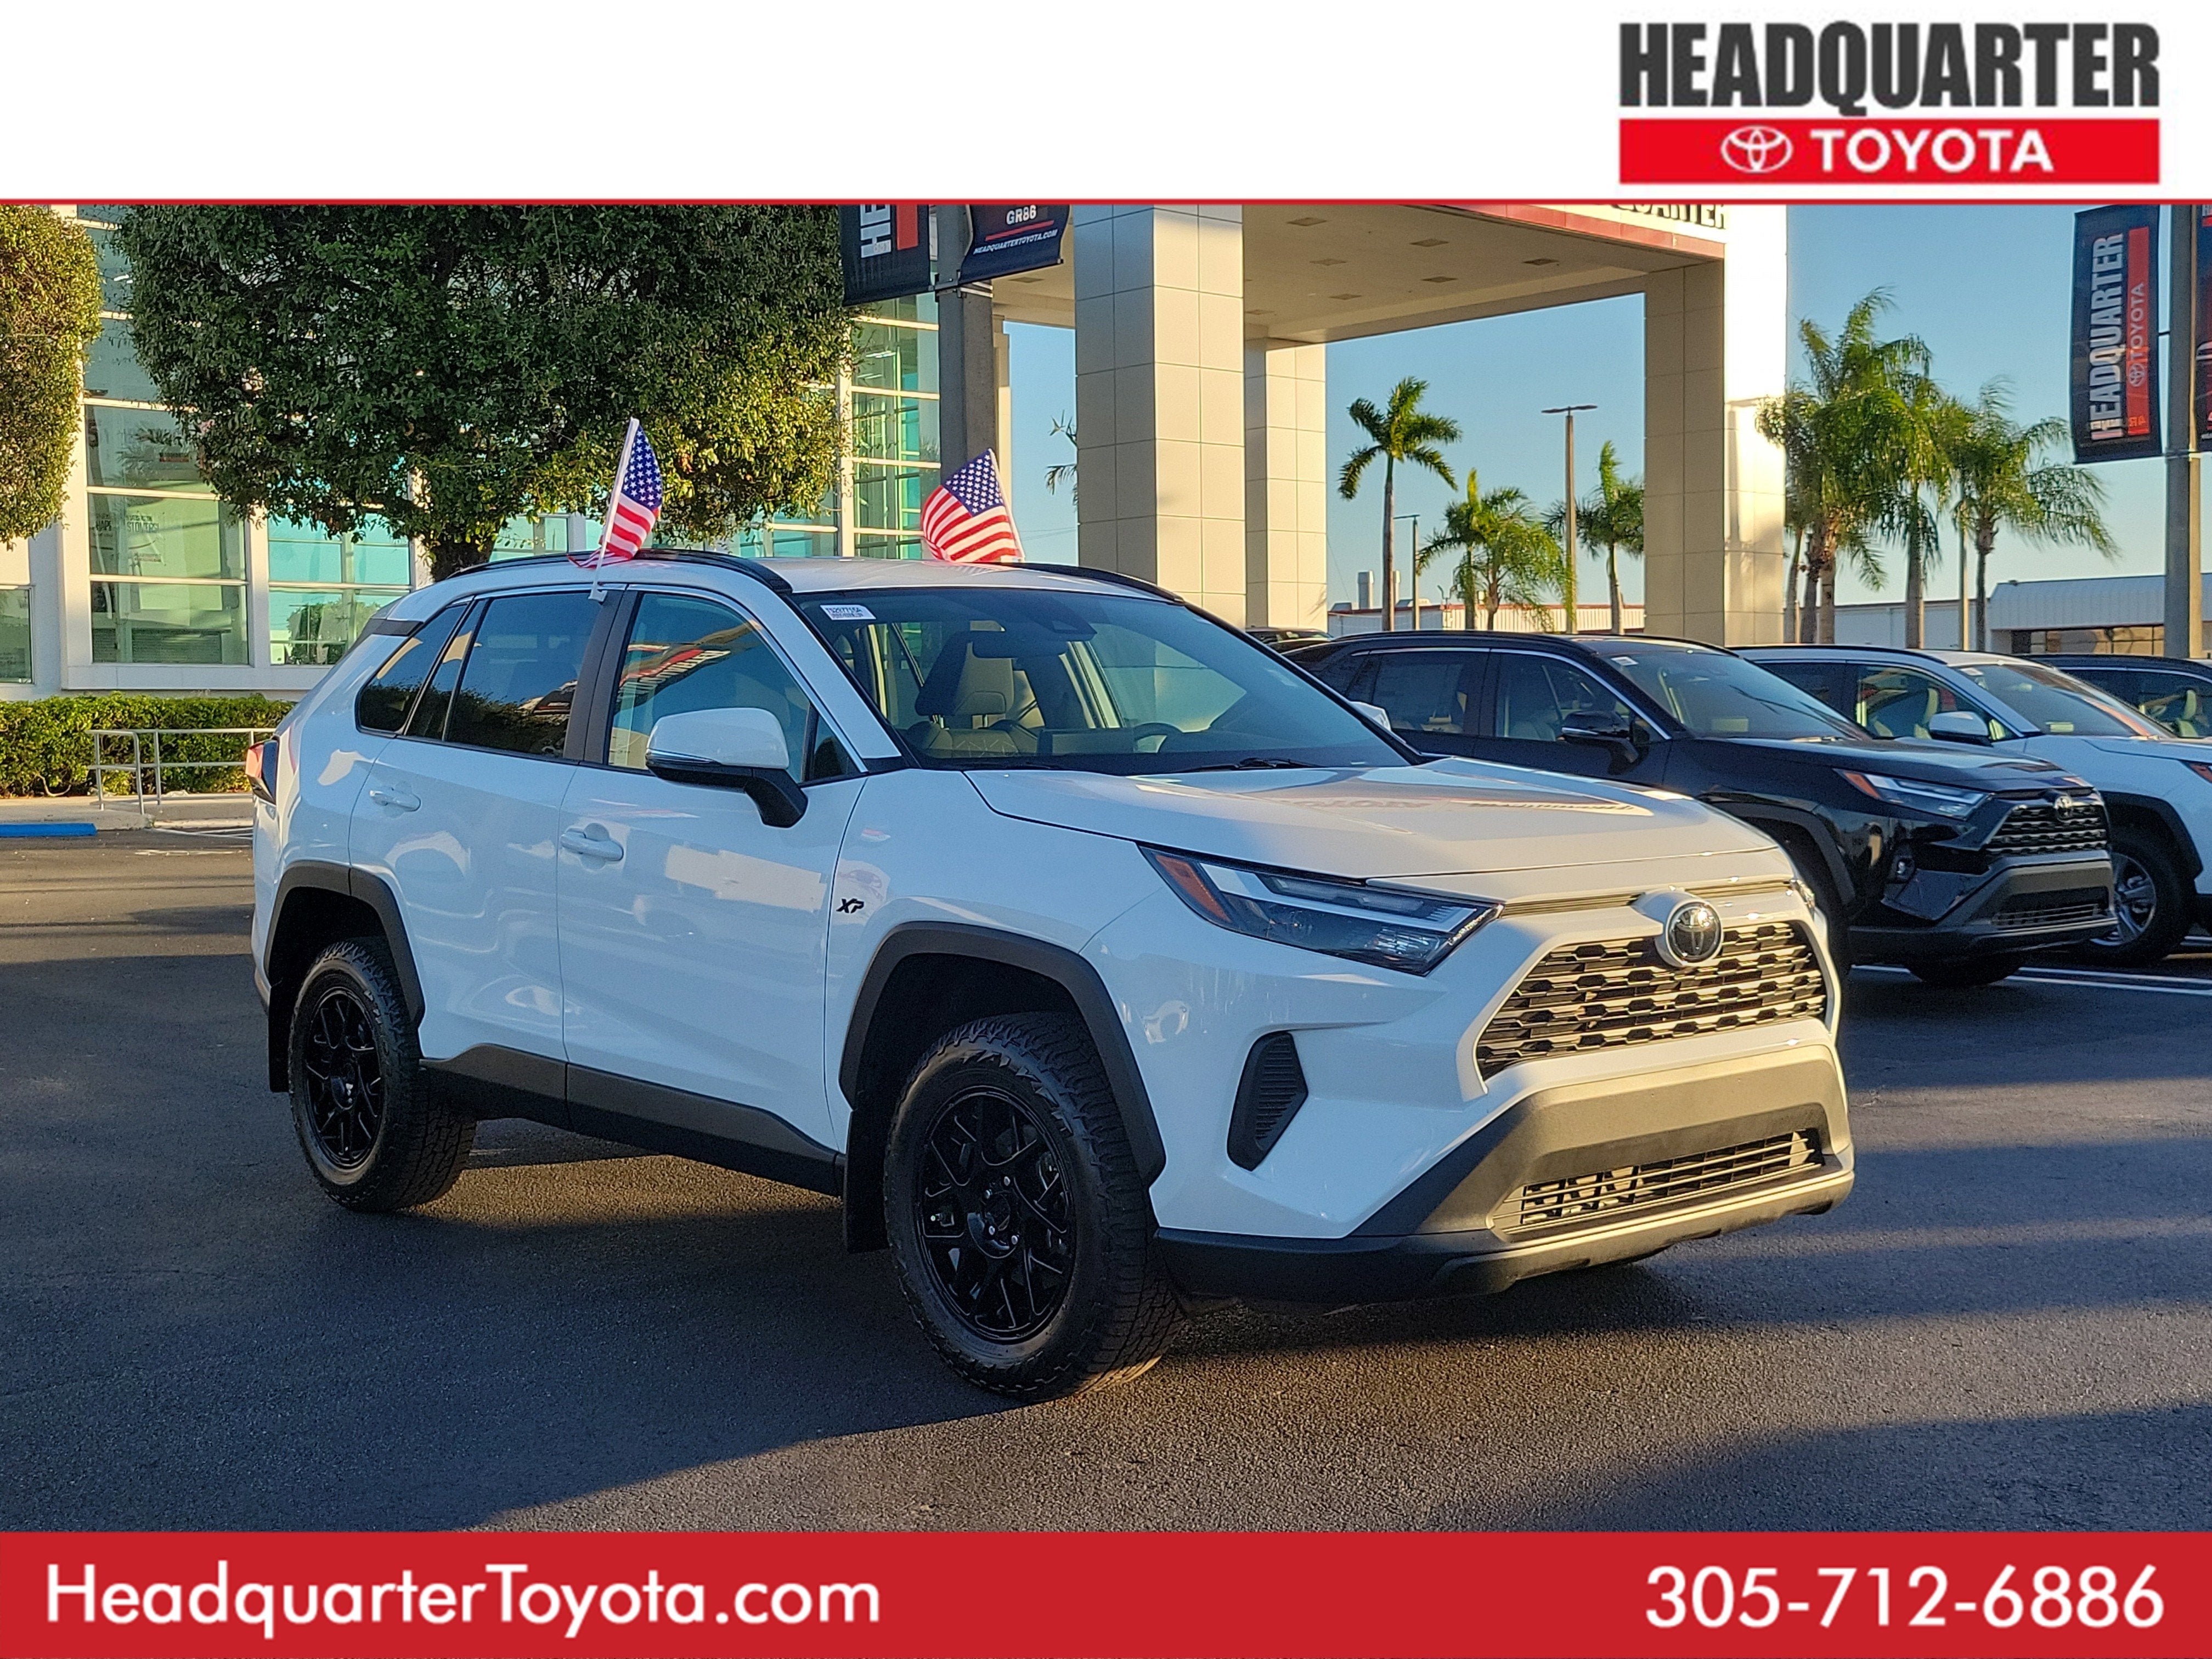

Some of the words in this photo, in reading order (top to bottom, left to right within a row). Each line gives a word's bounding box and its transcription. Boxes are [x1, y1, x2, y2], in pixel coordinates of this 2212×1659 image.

[1006, 205, 1037, 224] GR86
[973, 229, 1058, 255] HEADQUARTERTOYOTA.COM
[2089, 233, 2126, 440] HEADQUARTER
[2130, 283, 2146, 360] TOYOTA
